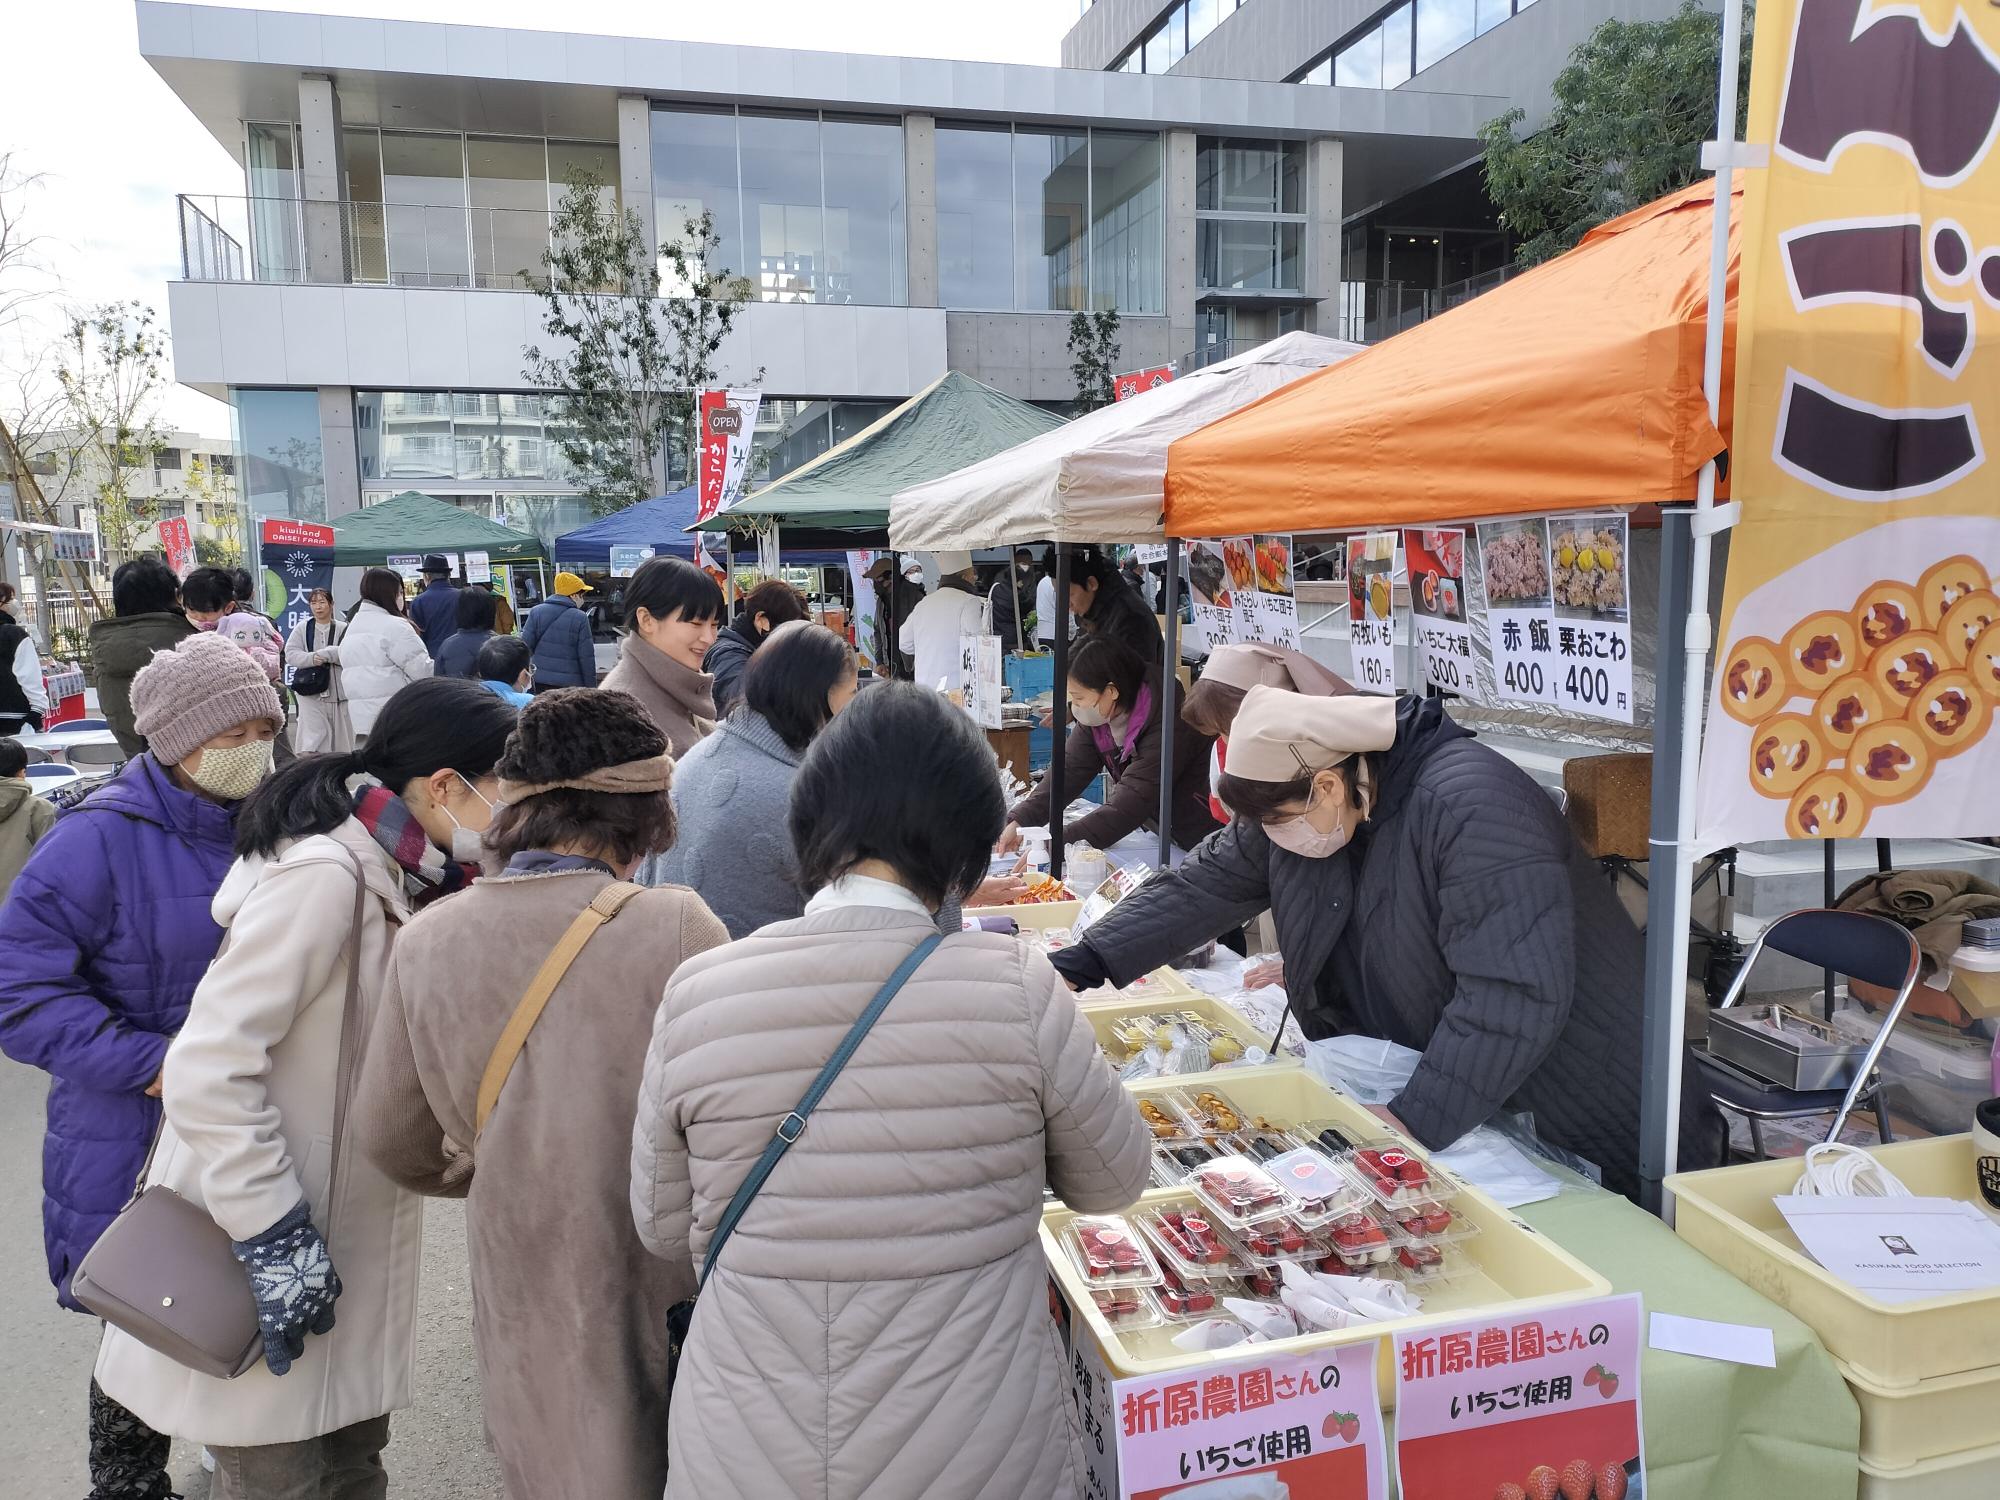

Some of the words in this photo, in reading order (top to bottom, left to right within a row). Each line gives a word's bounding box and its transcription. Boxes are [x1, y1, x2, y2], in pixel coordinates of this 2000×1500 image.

[712, 416, 738, 428] OPEN
[272, 534, 300, 542] DAISEI
[302, 537, 326, 545] FARM
[279, 525, 321, 538] kiwiland
[1233, 591, 1258, 608] みたらし
[1260, 596, 1294, 616] いちご団子
[1242, 609, 1255, 623] 団子
[1351, 622, 1392, 646] 内牧いも
[1416, 627, 1470, 658] いちご大福
[1502, 618, 1551, 653] 赤飯
[1558, 626, 1626, 662] 栗おこわ
[1360, 657, 1382, 685] 160
[1385, 668, 1391, 682] 円
[1428, 654, 1459, 687] 300
[1465, 674, 1474, 690] 円
[1504, 661, 1544, 695] 400
[1565, 664, 1609, 706] 400
[1617, 691, 1627, 710] 円
[1933, 1261, 1983, 1269] SELECTION
[1401, 1321, 1609, 1382] 折原農園さんの
[1122, 1365, 1341, 1437] 折原農園さんの
[1450, 1375, 1573, 1420] いちご使用
[1179, 1424, 1312, 1480] いちご使用
